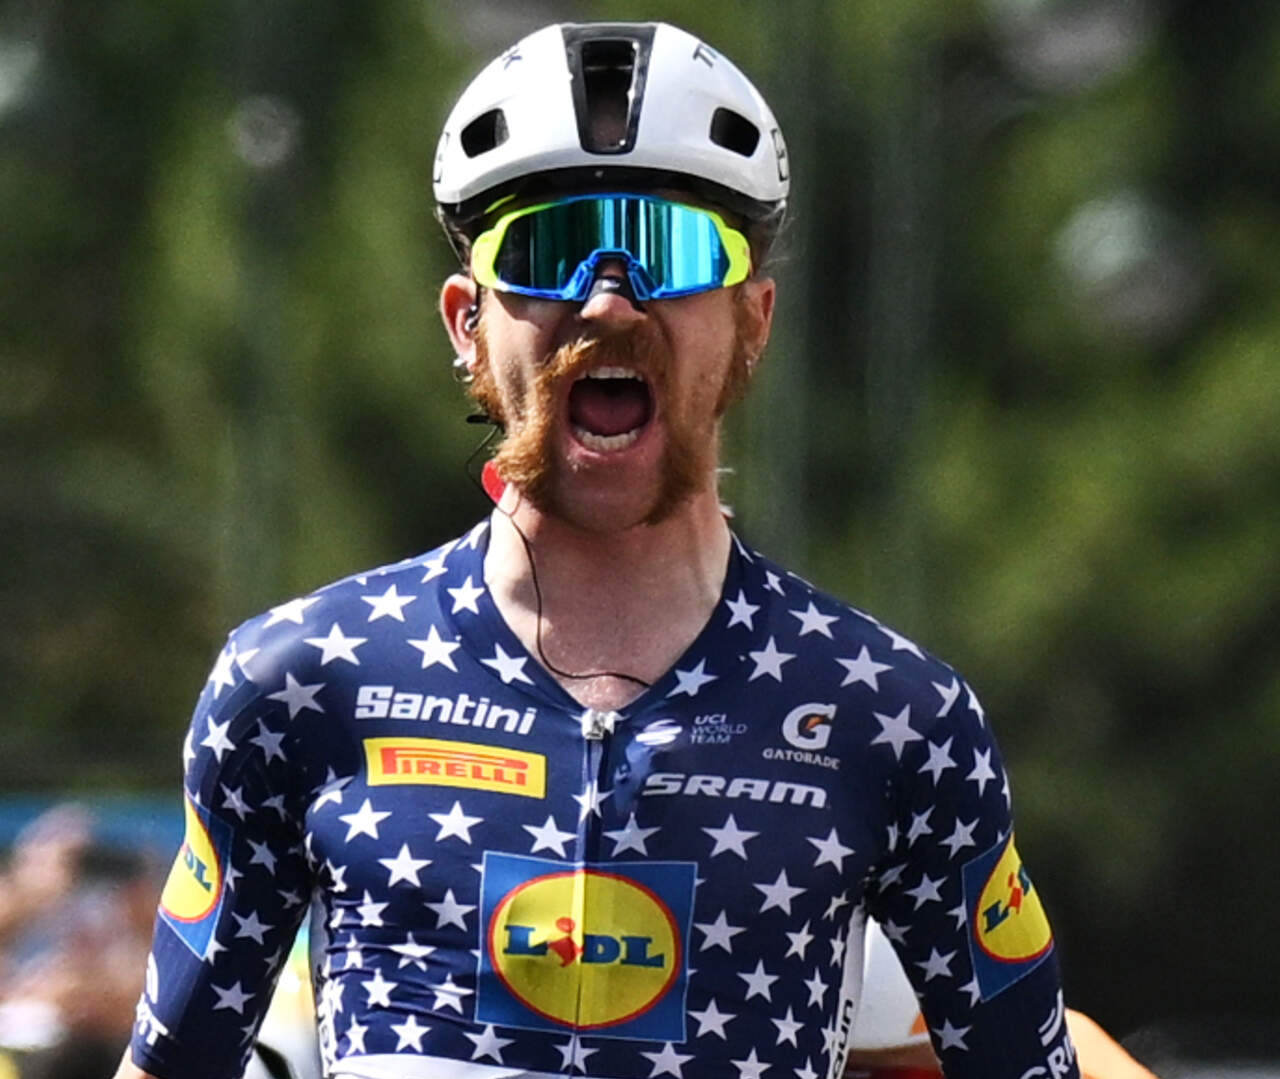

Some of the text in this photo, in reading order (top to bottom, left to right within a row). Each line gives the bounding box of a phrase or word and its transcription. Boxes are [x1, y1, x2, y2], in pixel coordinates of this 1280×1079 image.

[355, 685, 537, 735] Santini
[694, 713, 727, 725] UCI
[690, 734, 730, 744] TEAM
[691, 724, 747, 735] WORLD
[380, 747, 529, 787] PIRELLI
[762, 748, 841, 770] GATORADE
[642, 772, 827, 808] SRAM
